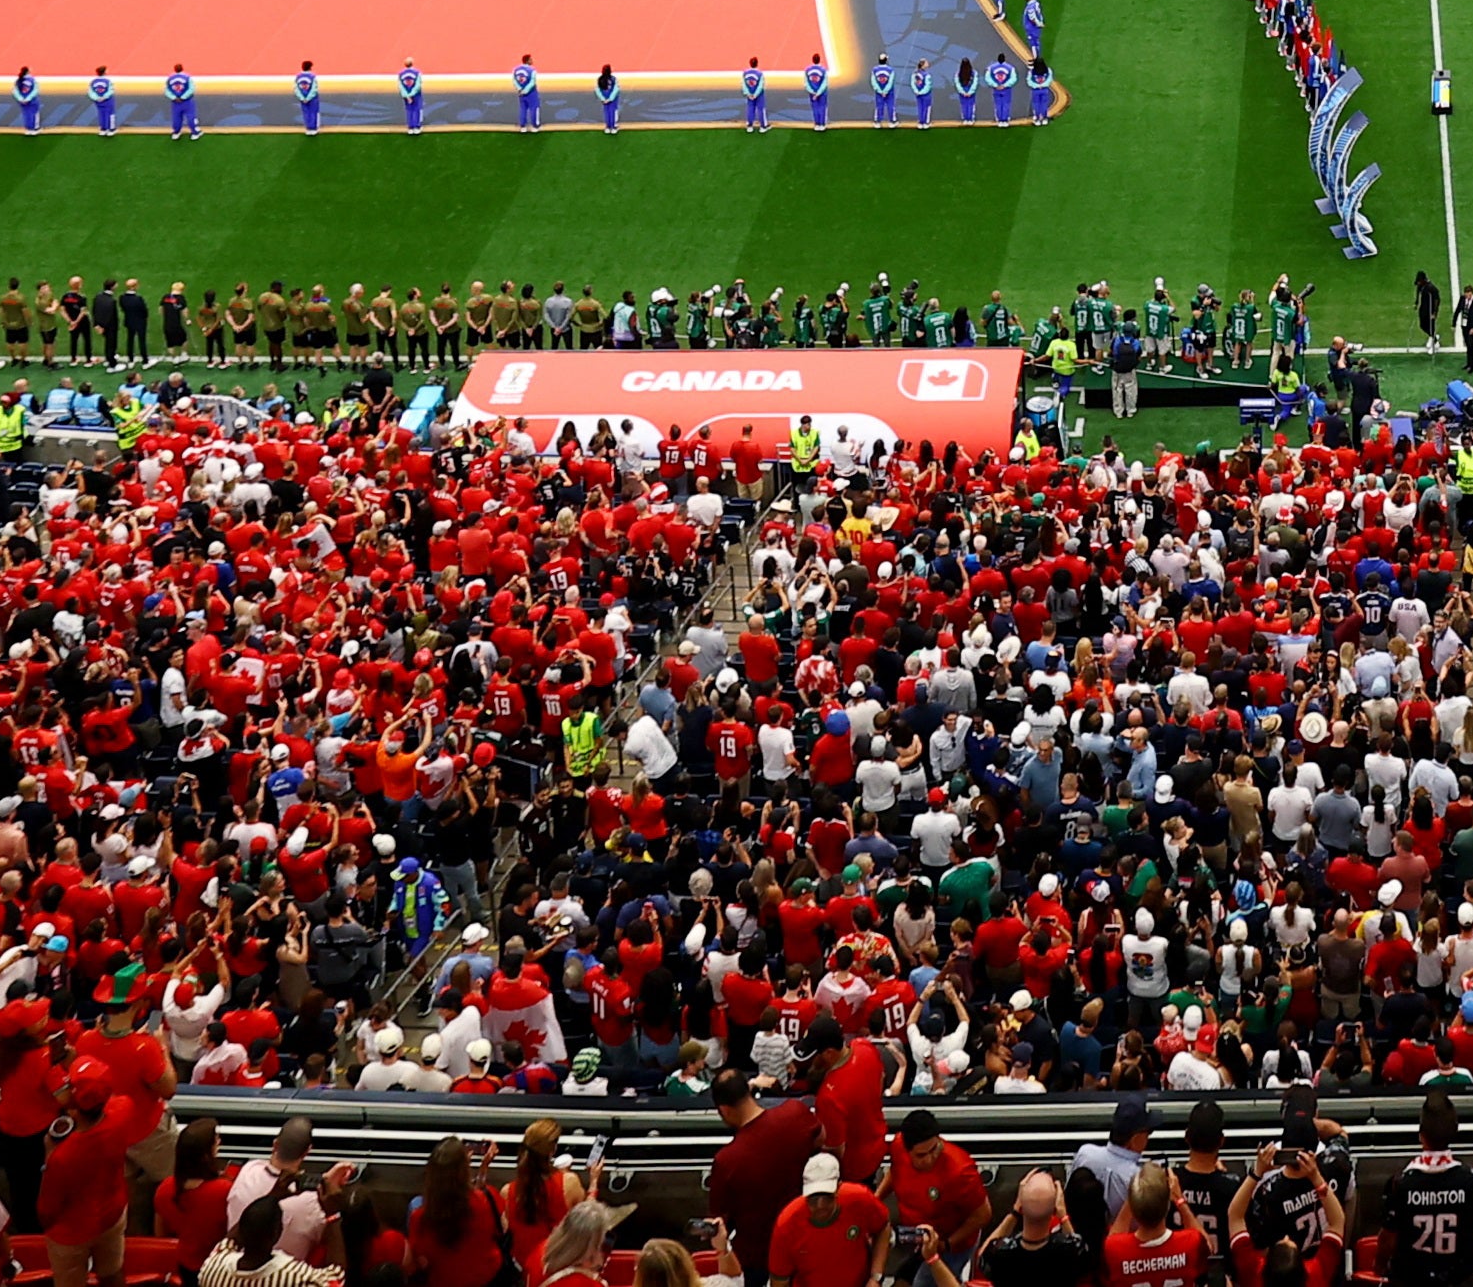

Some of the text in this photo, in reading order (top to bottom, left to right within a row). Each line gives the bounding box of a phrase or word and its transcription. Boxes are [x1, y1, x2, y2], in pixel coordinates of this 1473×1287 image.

[621, 369, 803, 393] CANADA
[665, 449, 680, 463] 19
[695, 448, 707, 465] 19
[849, 529, 863, 545] 10
[550, 571, 568, 591] 19
[1364, 607, 1382, 624] 10
[1397, 602, 1418, 612] USA
[494, 696, 511, 716] 19
[546, 703, 562, 719] 10
[720, 736, 737, 758] 19
[593, 993, 605, 1021] 11
[885, 1002, 906, 1032] 19
[780, 1017, 800, 1041] 19
[1407, 1189, 1466, 1206] JOHNSTON
[1412, 1213, 1457, 1254] 26
